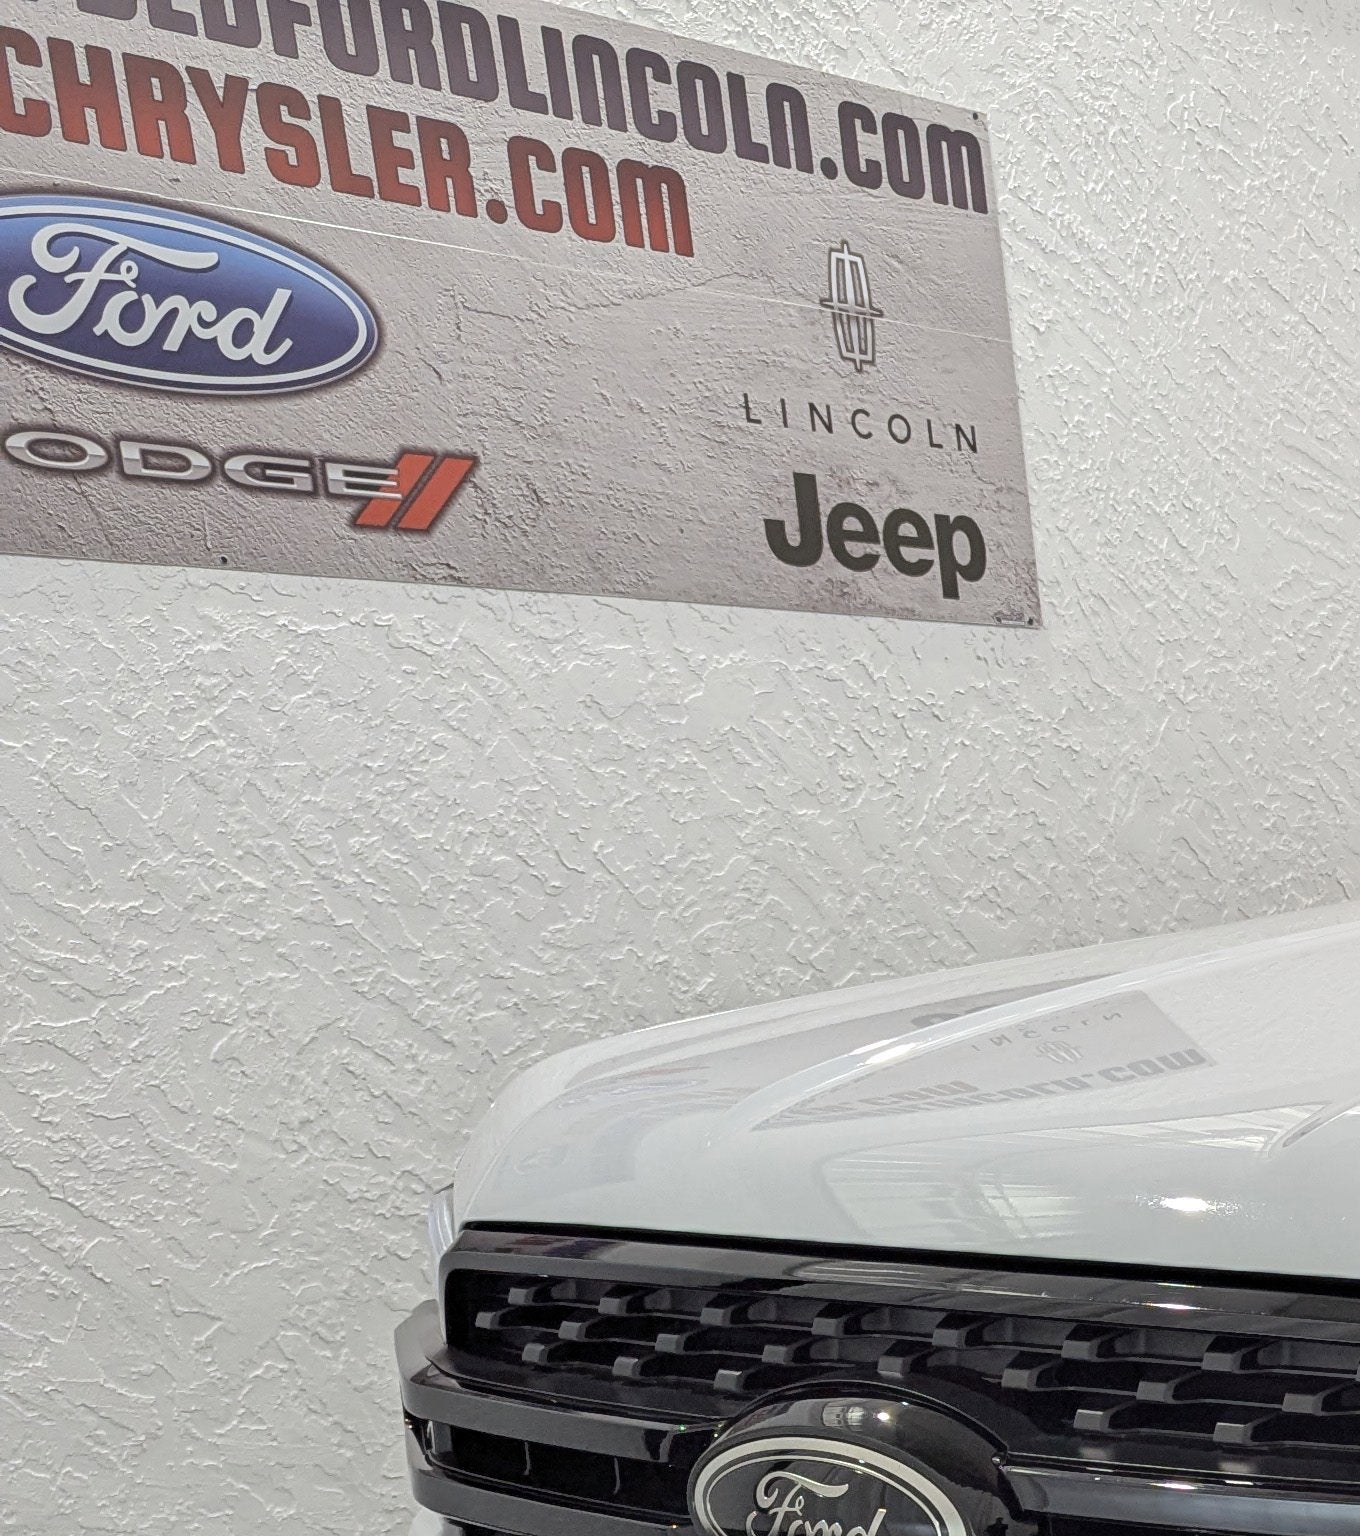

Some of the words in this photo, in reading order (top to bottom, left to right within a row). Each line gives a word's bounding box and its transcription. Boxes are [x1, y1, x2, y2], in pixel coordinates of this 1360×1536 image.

[0, 25, 694, 257] CHRYSLER.COM
[76, 0, 988, 214] FORDLINCOLN.COM
[8, 222, 293, 365] Ford
[743, 393, 978, 453] LINCOLN
[763, 471, 987, 600] Jeep
